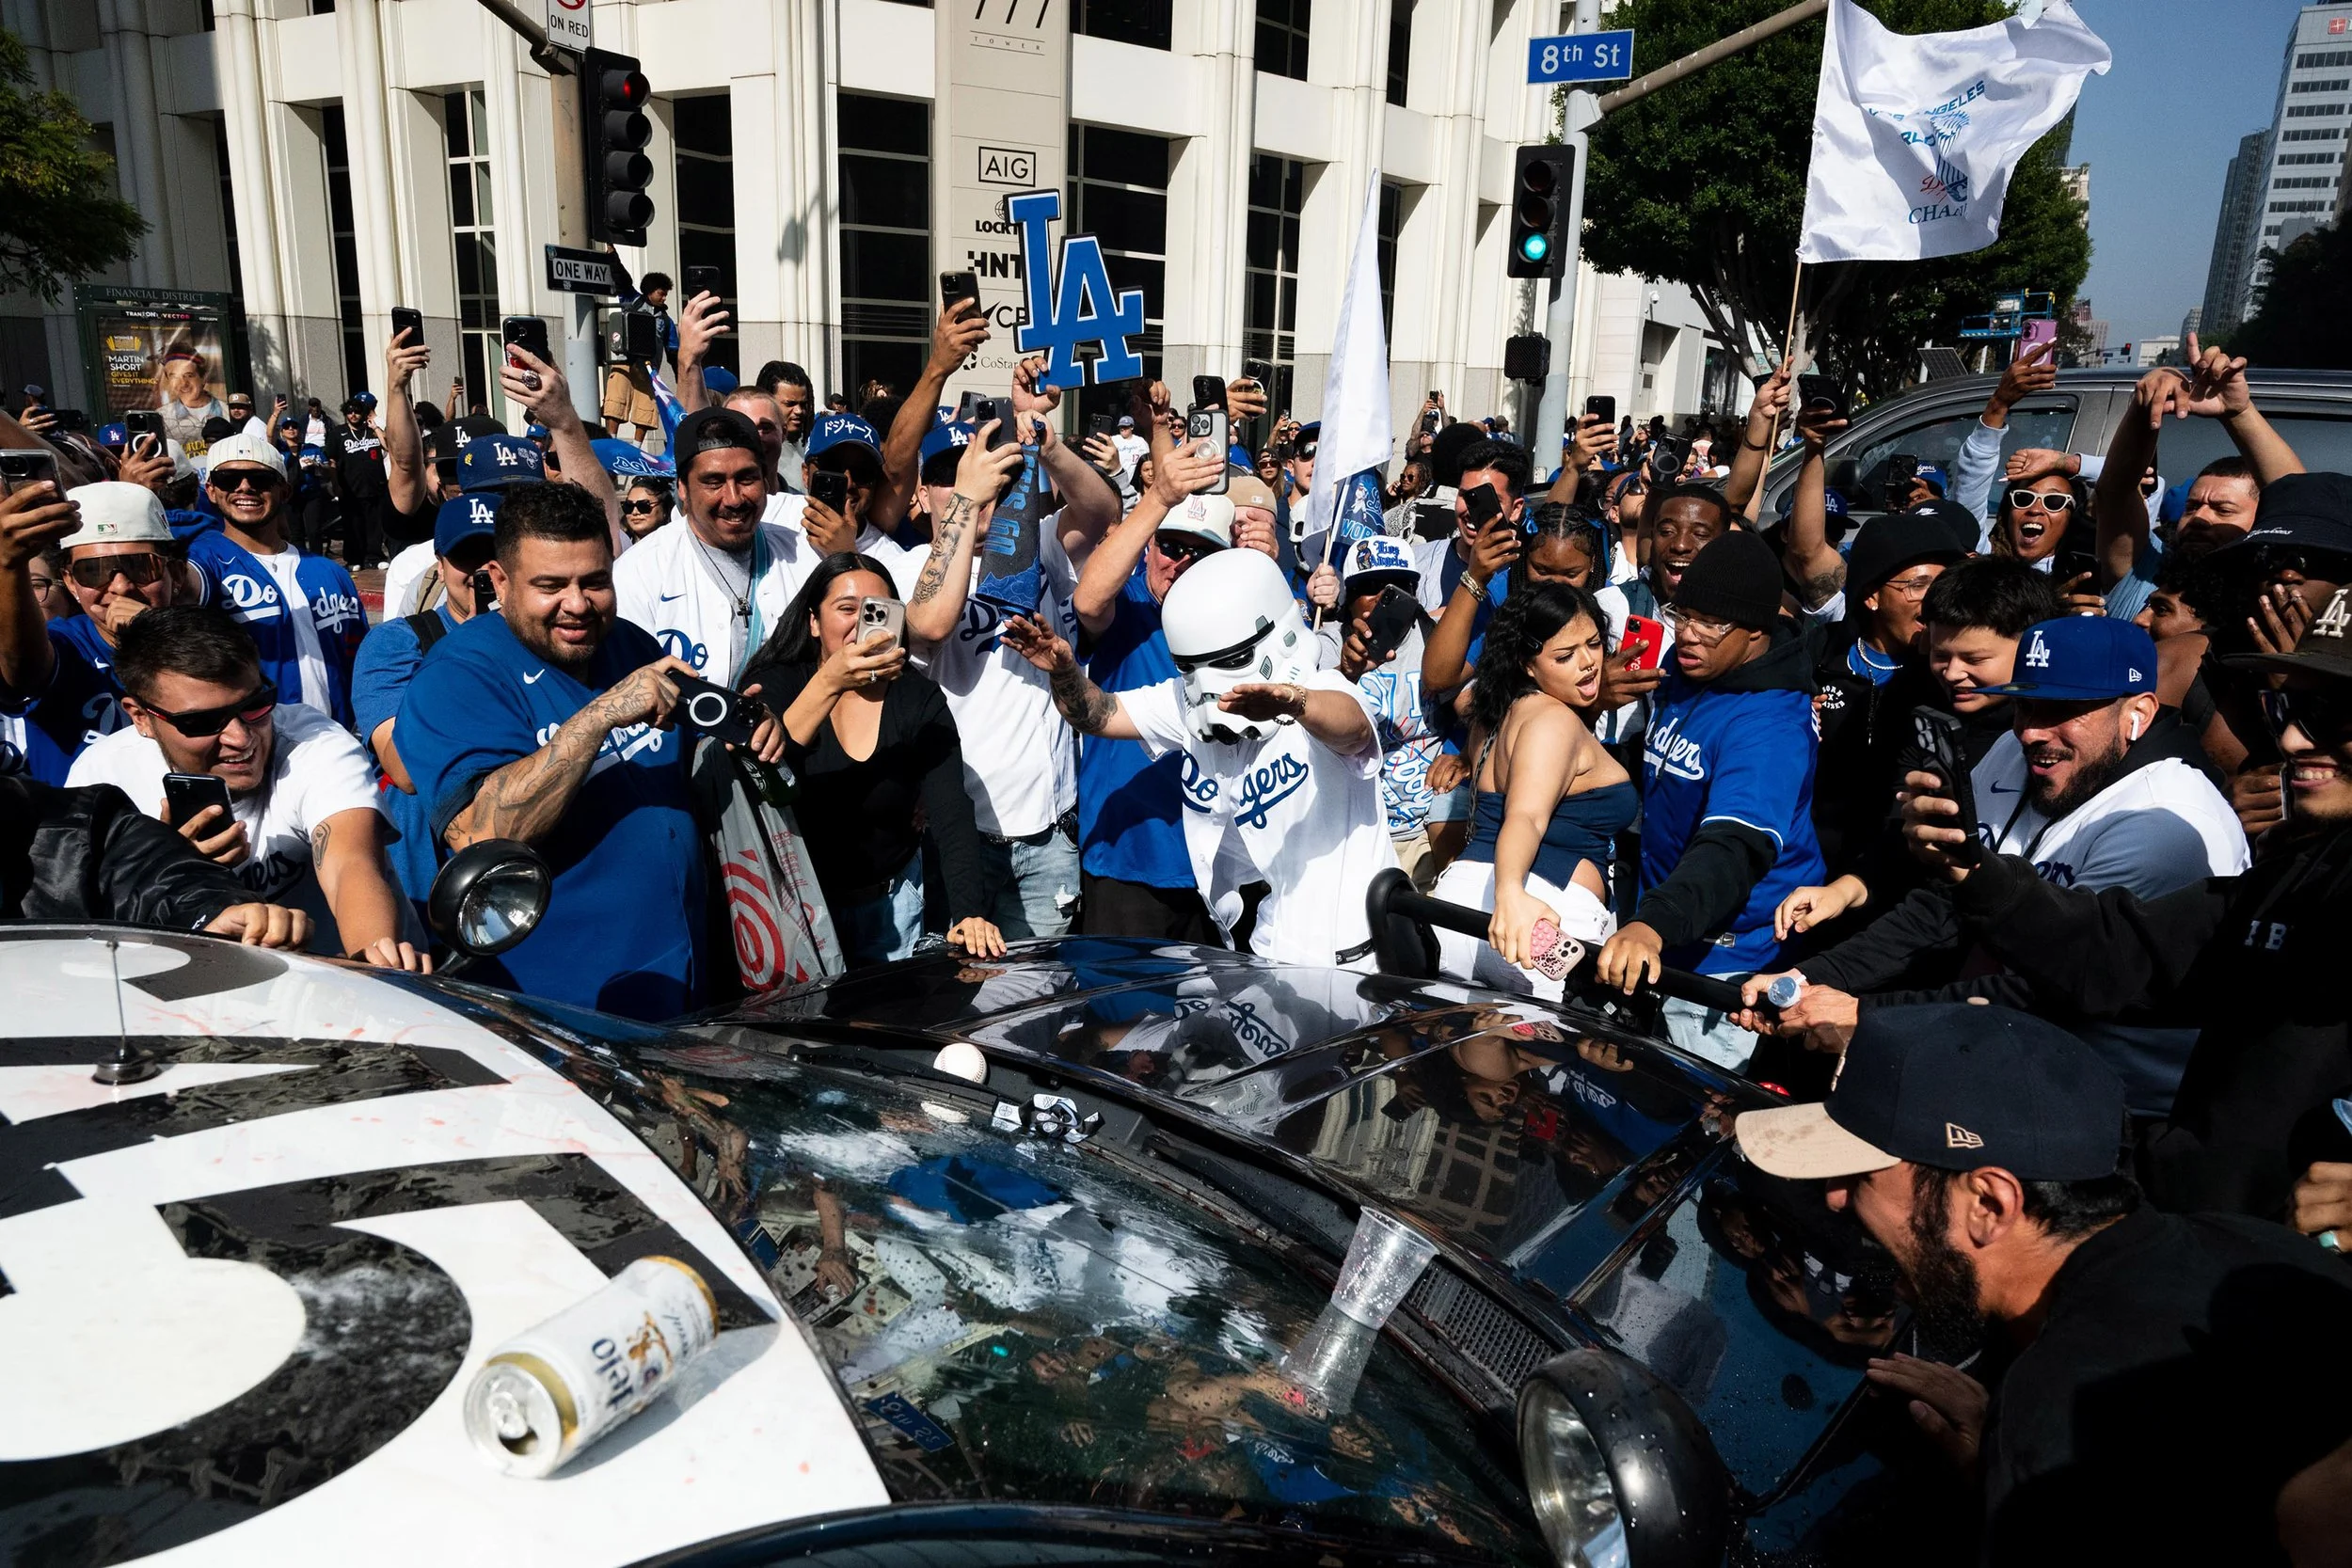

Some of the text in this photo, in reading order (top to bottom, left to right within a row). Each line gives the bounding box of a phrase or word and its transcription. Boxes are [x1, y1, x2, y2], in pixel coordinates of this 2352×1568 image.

[550, 15, 589, 38] ON RED
[975, 36, 1041, 51] TOWER
[1541, 43, 1621, 74] 8th St
[1923, 80, 1985, 117] NGELES
[984, 154, 1029, 180] AIG
[976, 220, 1018, 235] LOCKT
[556, 261, 608, 282] ONE WAY
[968, 251, 1022, 279] HNT
[106, 288, 204, 302] FINANCIAL DISTRICT
[1003, 188, 1145, 394] LA
[110, 363, 142, 372] SHORT
[980, 356, 1018, 369] CoStar
[455, 426, 471, 448] LA
[823, 418, 875, 444] ドジャース
[948, 427, 969, 447] LA
[493, 442, 518, 467] LA
[469, 498, 494, 524] LA
[1188, 496, 1207, 522] LA
[1825, 493, 1838, 513] LA
[2312, 589, 2351, 639] LA
[2026, 630, 2050, 668] LA
